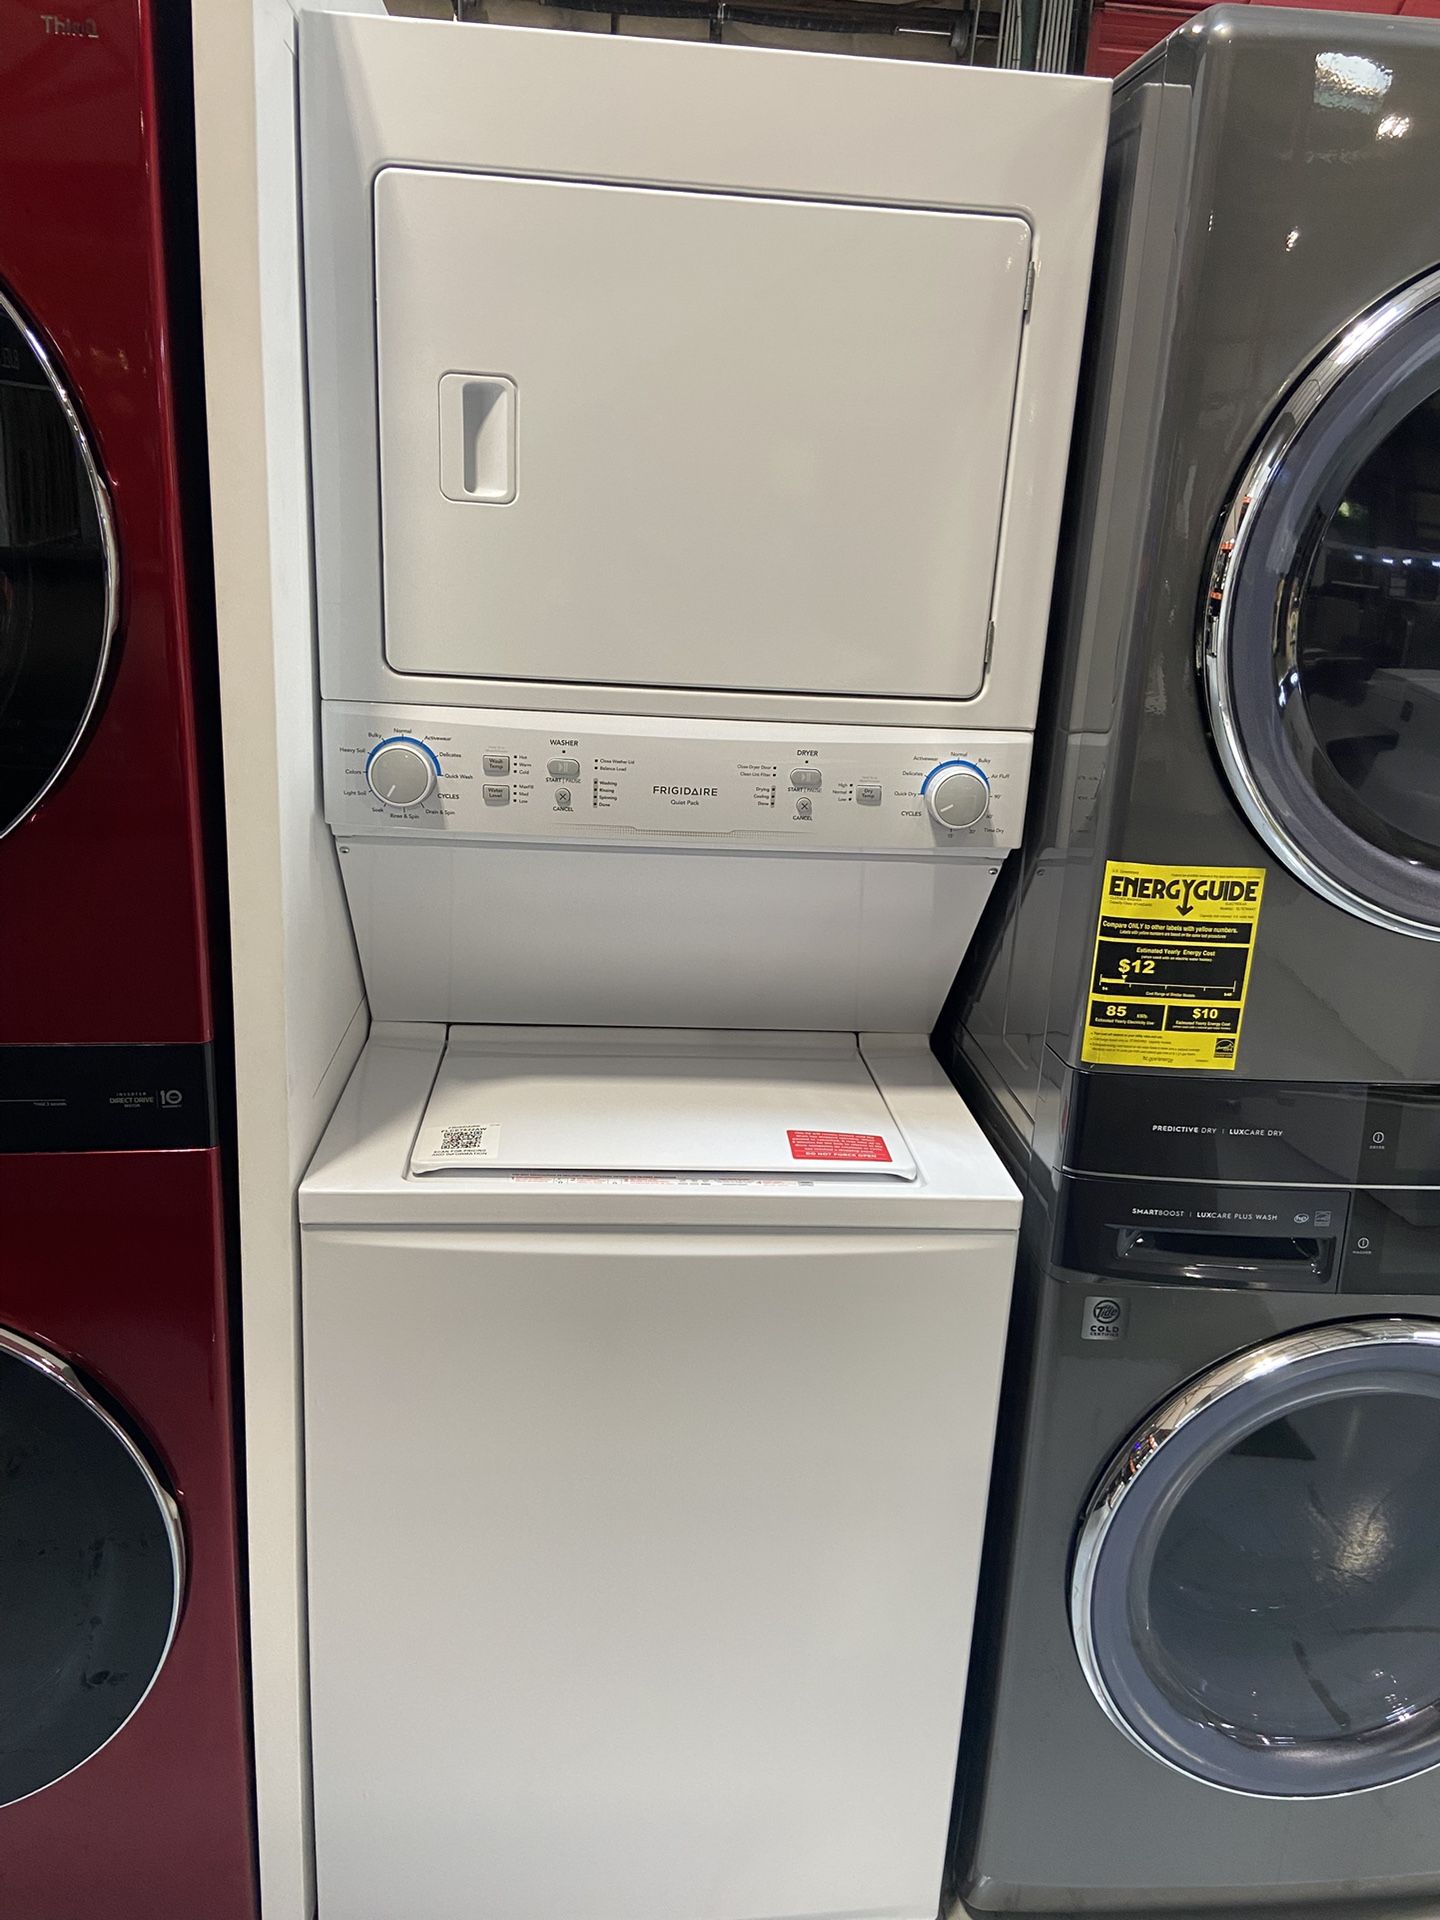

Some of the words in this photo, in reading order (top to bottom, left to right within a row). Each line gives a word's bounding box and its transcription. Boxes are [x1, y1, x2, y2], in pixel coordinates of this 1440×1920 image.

[41, 15, 99, 38] ThinQ
[652, 785, 719, 797] FRIGIDAIRE
[670, 799, 688, 807] Quiet
[1109, 875, 1259, 903] ENERGYGUIDE
[1102, 920, 1128, 930] Compare
[1128, 922, 1144, 930] ONLY
[1136, 946, 1163, 954] Estimated
[1164, 948, 1180, 956] Yearly
[1182, 950, 1202, 958] Energy
[1118, 958, 1155, 974] $12
[1106, 1005, 1128, 1016] 85
[1192, 1008, 1218, 1020] $10
[1152, 1125, 1199, 1134] PREDICTIVE
[1132, 1208, 1184, 1217] SMARTBOOST
[1096, 1304, 1118, 1320] Tide
[1090, 1325, 1120, 1333] COLD
